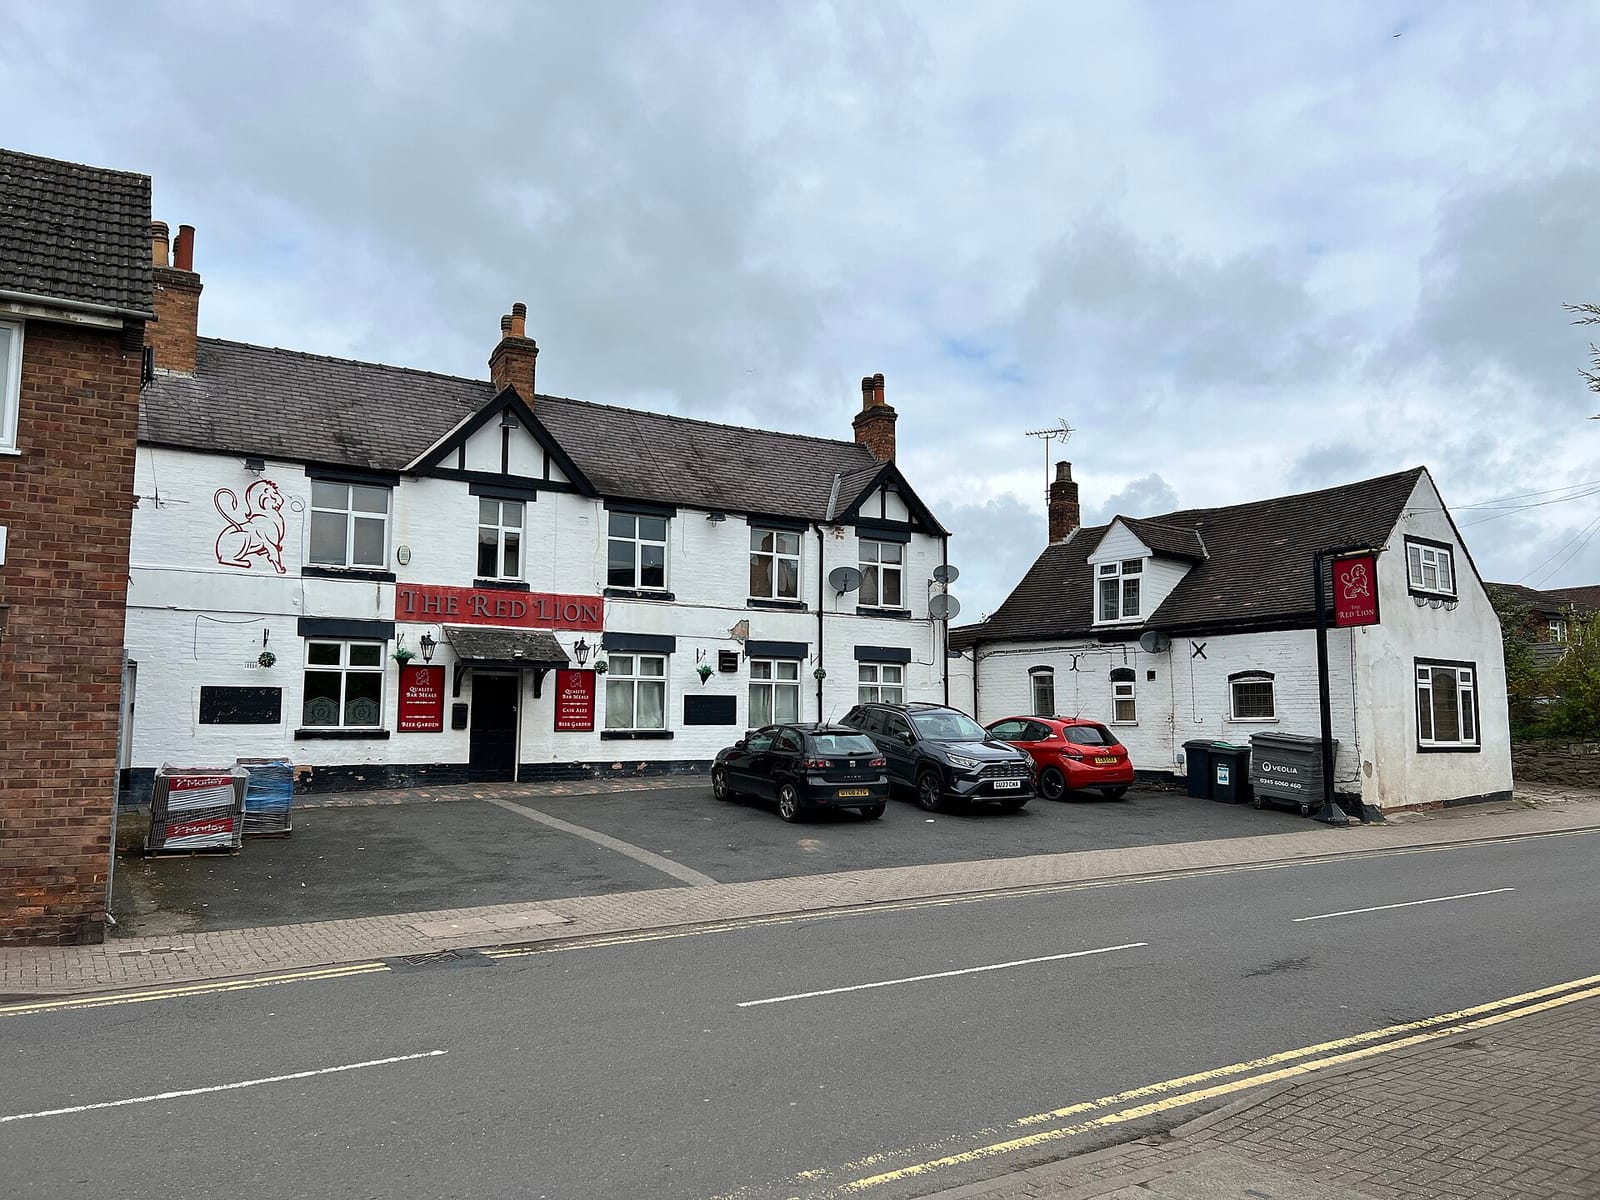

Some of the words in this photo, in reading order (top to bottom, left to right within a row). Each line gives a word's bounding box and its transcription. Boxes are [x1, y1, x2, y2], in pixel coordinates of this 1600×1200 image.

[400, 589, 460, 616] THE
[467, 594, 527, 618] RED
[534, 598, 600, 623] LION
[1338, 611, 1355, 619] RED
[1355, 609, 1375, 617] LION
[409, 686, 433, 694] QUALITY
[1271, 765, 1298, 774] VEOLIA
